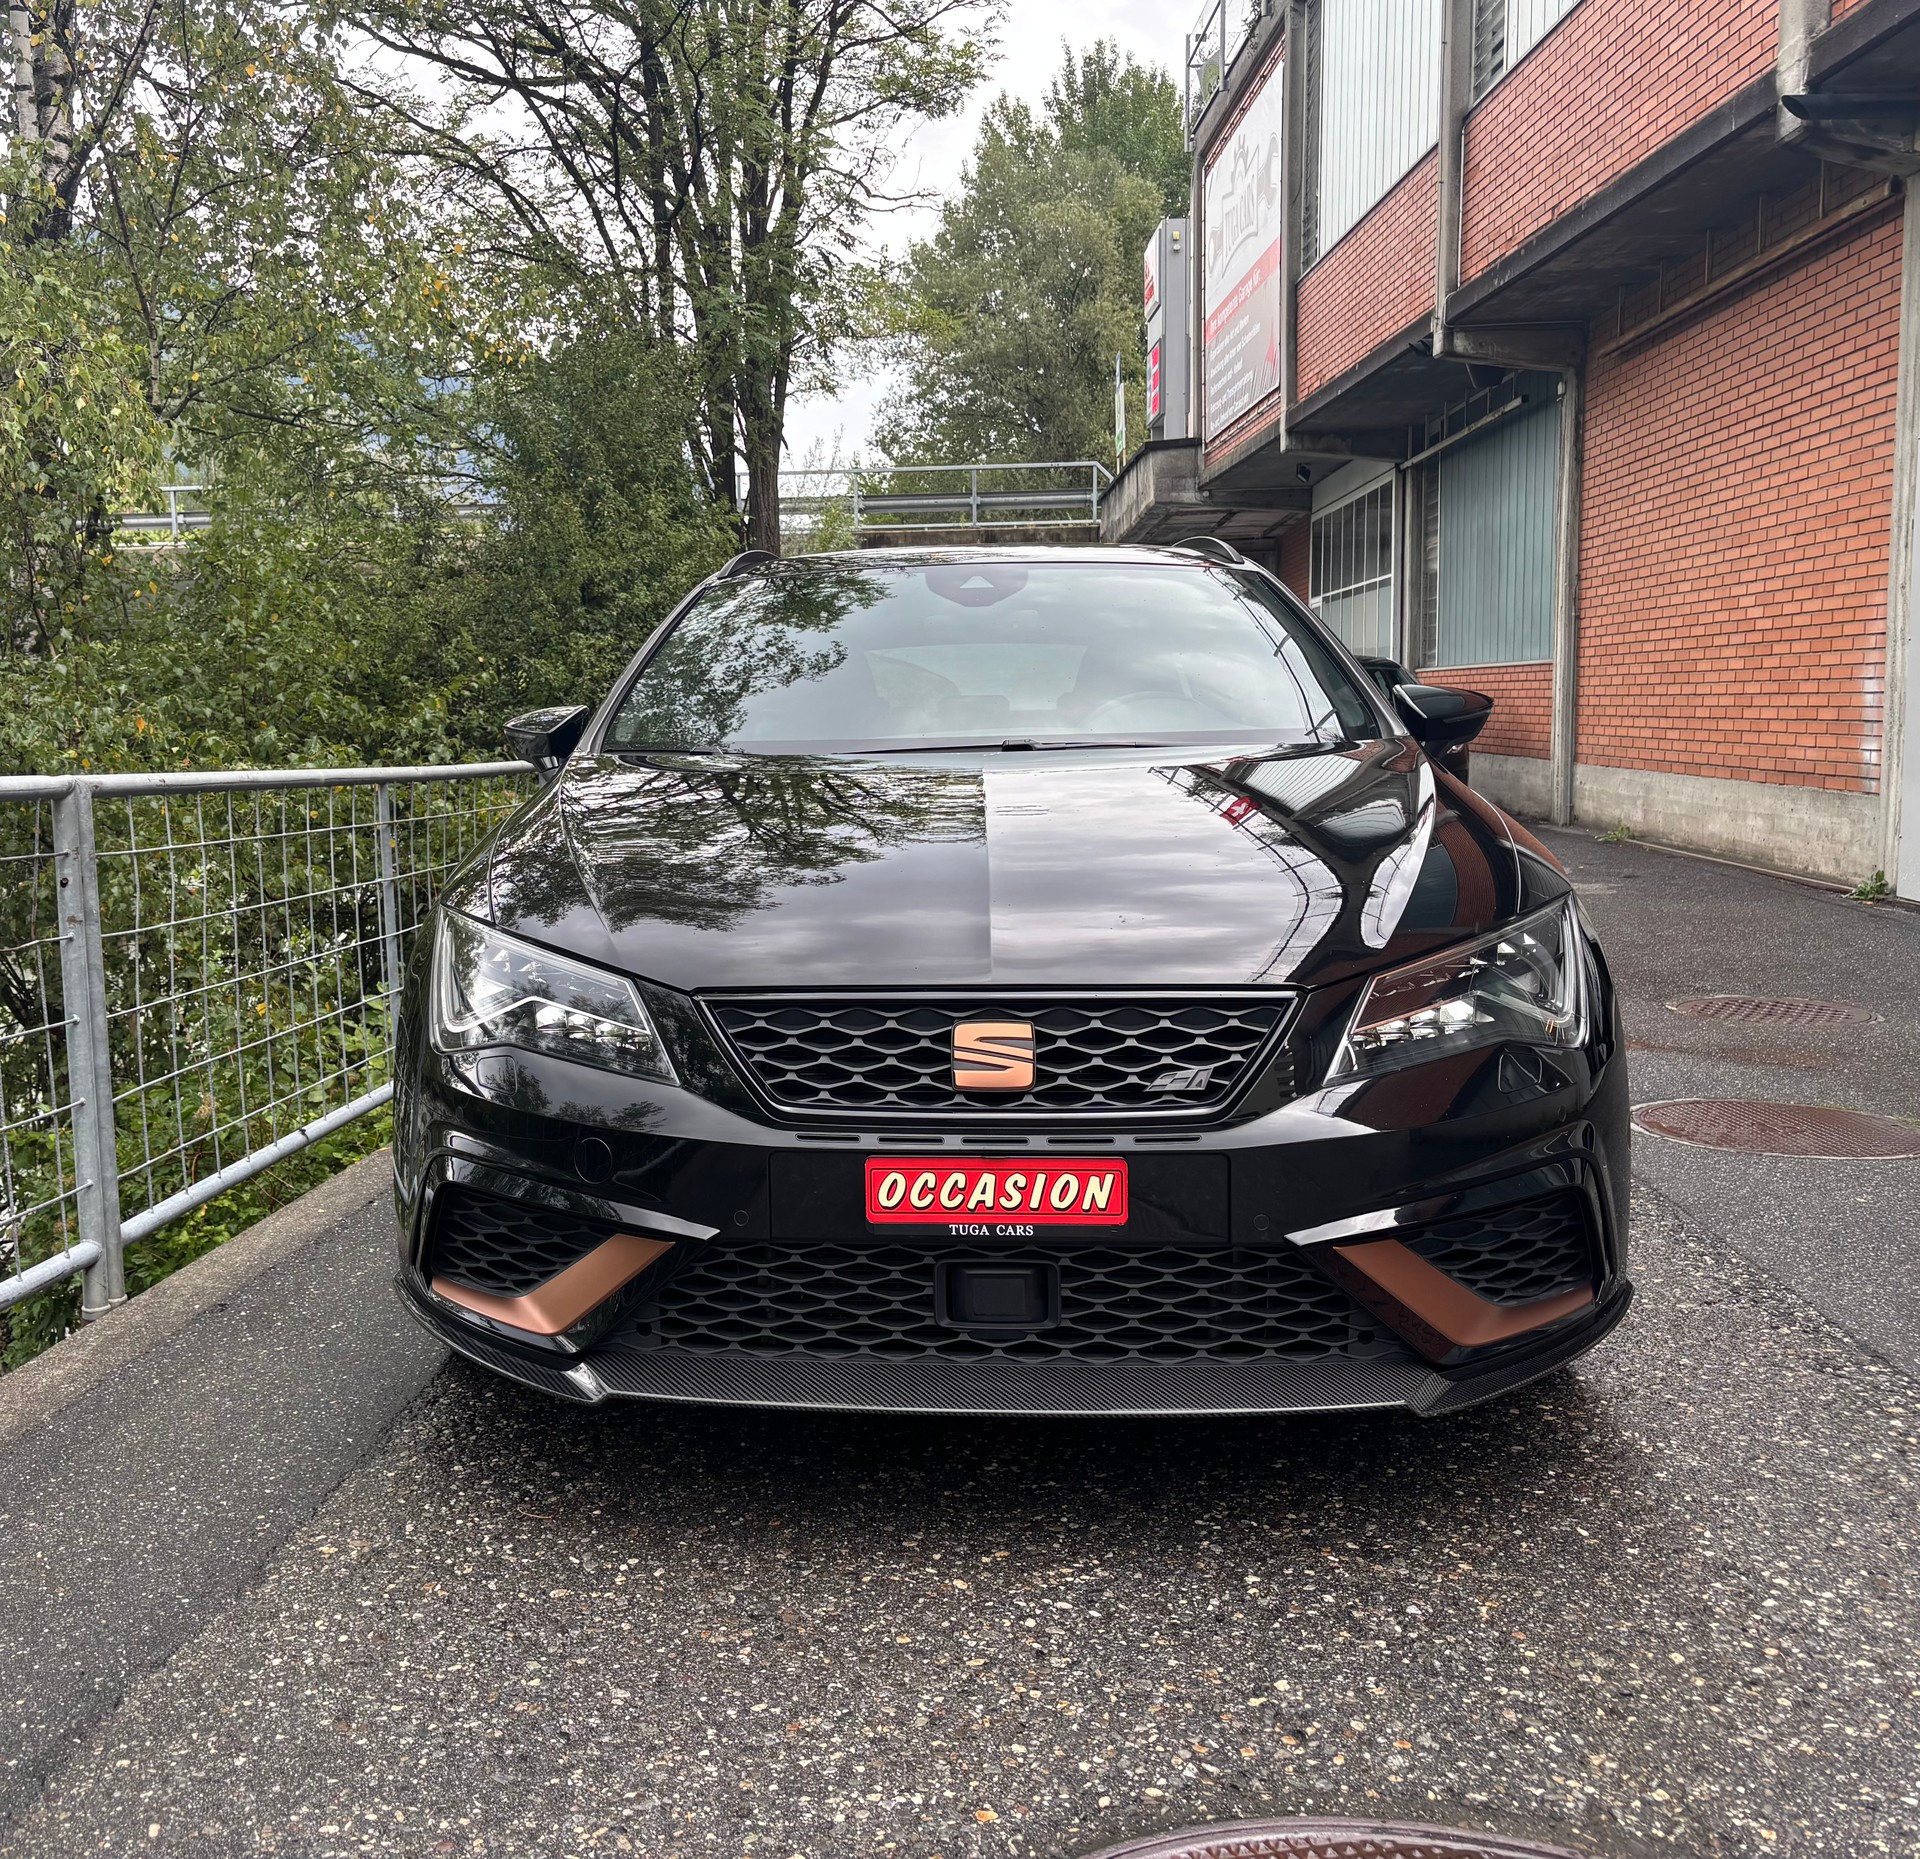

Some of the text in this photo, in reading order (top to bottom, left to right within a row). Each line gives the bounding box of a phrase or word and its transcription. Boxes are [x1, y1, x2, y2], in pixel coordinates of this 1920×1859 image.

[878, 1172, 1115, 1211] OCCASION
[949, 1224, 1034, 1236] TUGA CARS
